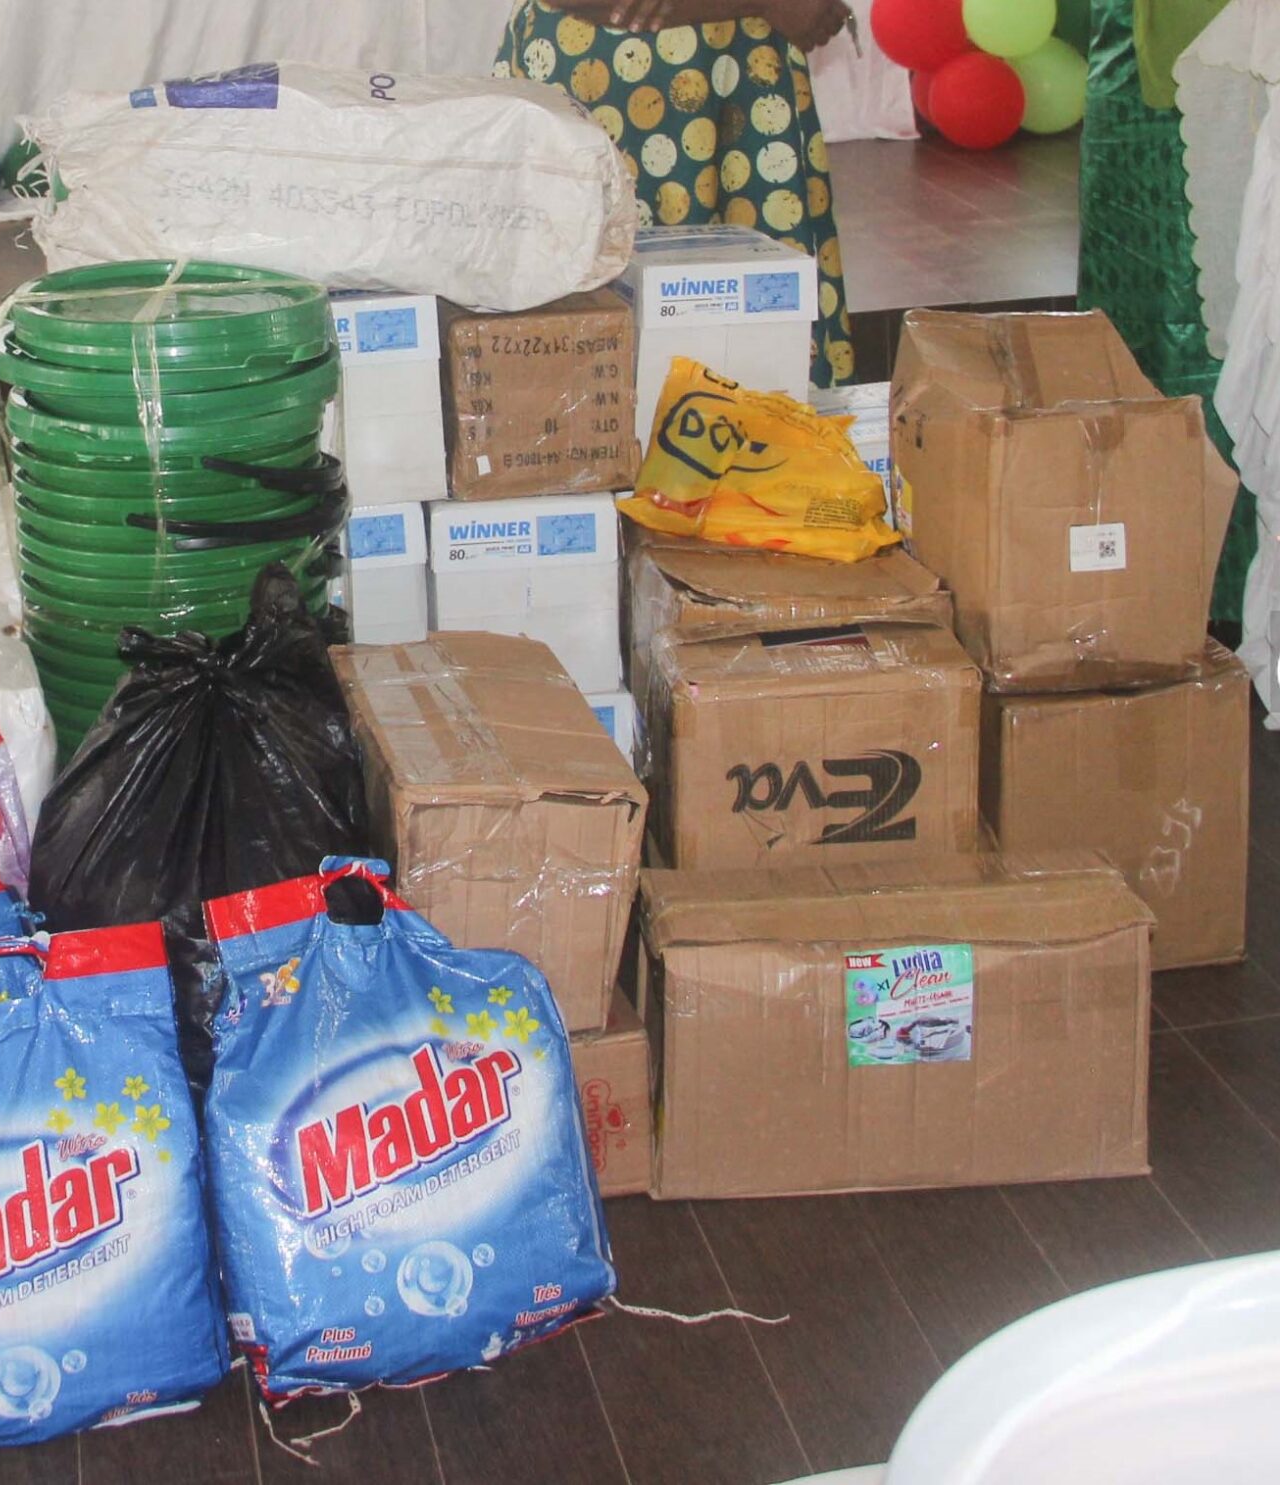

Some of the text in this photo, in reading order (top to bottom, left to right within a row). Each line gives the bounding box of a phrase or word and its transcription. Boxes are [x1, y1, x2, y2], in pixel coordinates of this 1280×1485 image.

[660, 306, 676, 317] 80
[449, 549, 465, 561] 80
[892, 950, 943, 978] Lydia
[890, 969, 951, 1000] Clean
[296, 1044, 519, 1217] Madar
[315, 1129, 521, 1249] HIGH FOAM DETERGENT
[18, 1234, 131, 1301] DETERGENT
[321, 1327, 356, 1343] Plus
[306, 1341, 372, 1362] Parfumé
